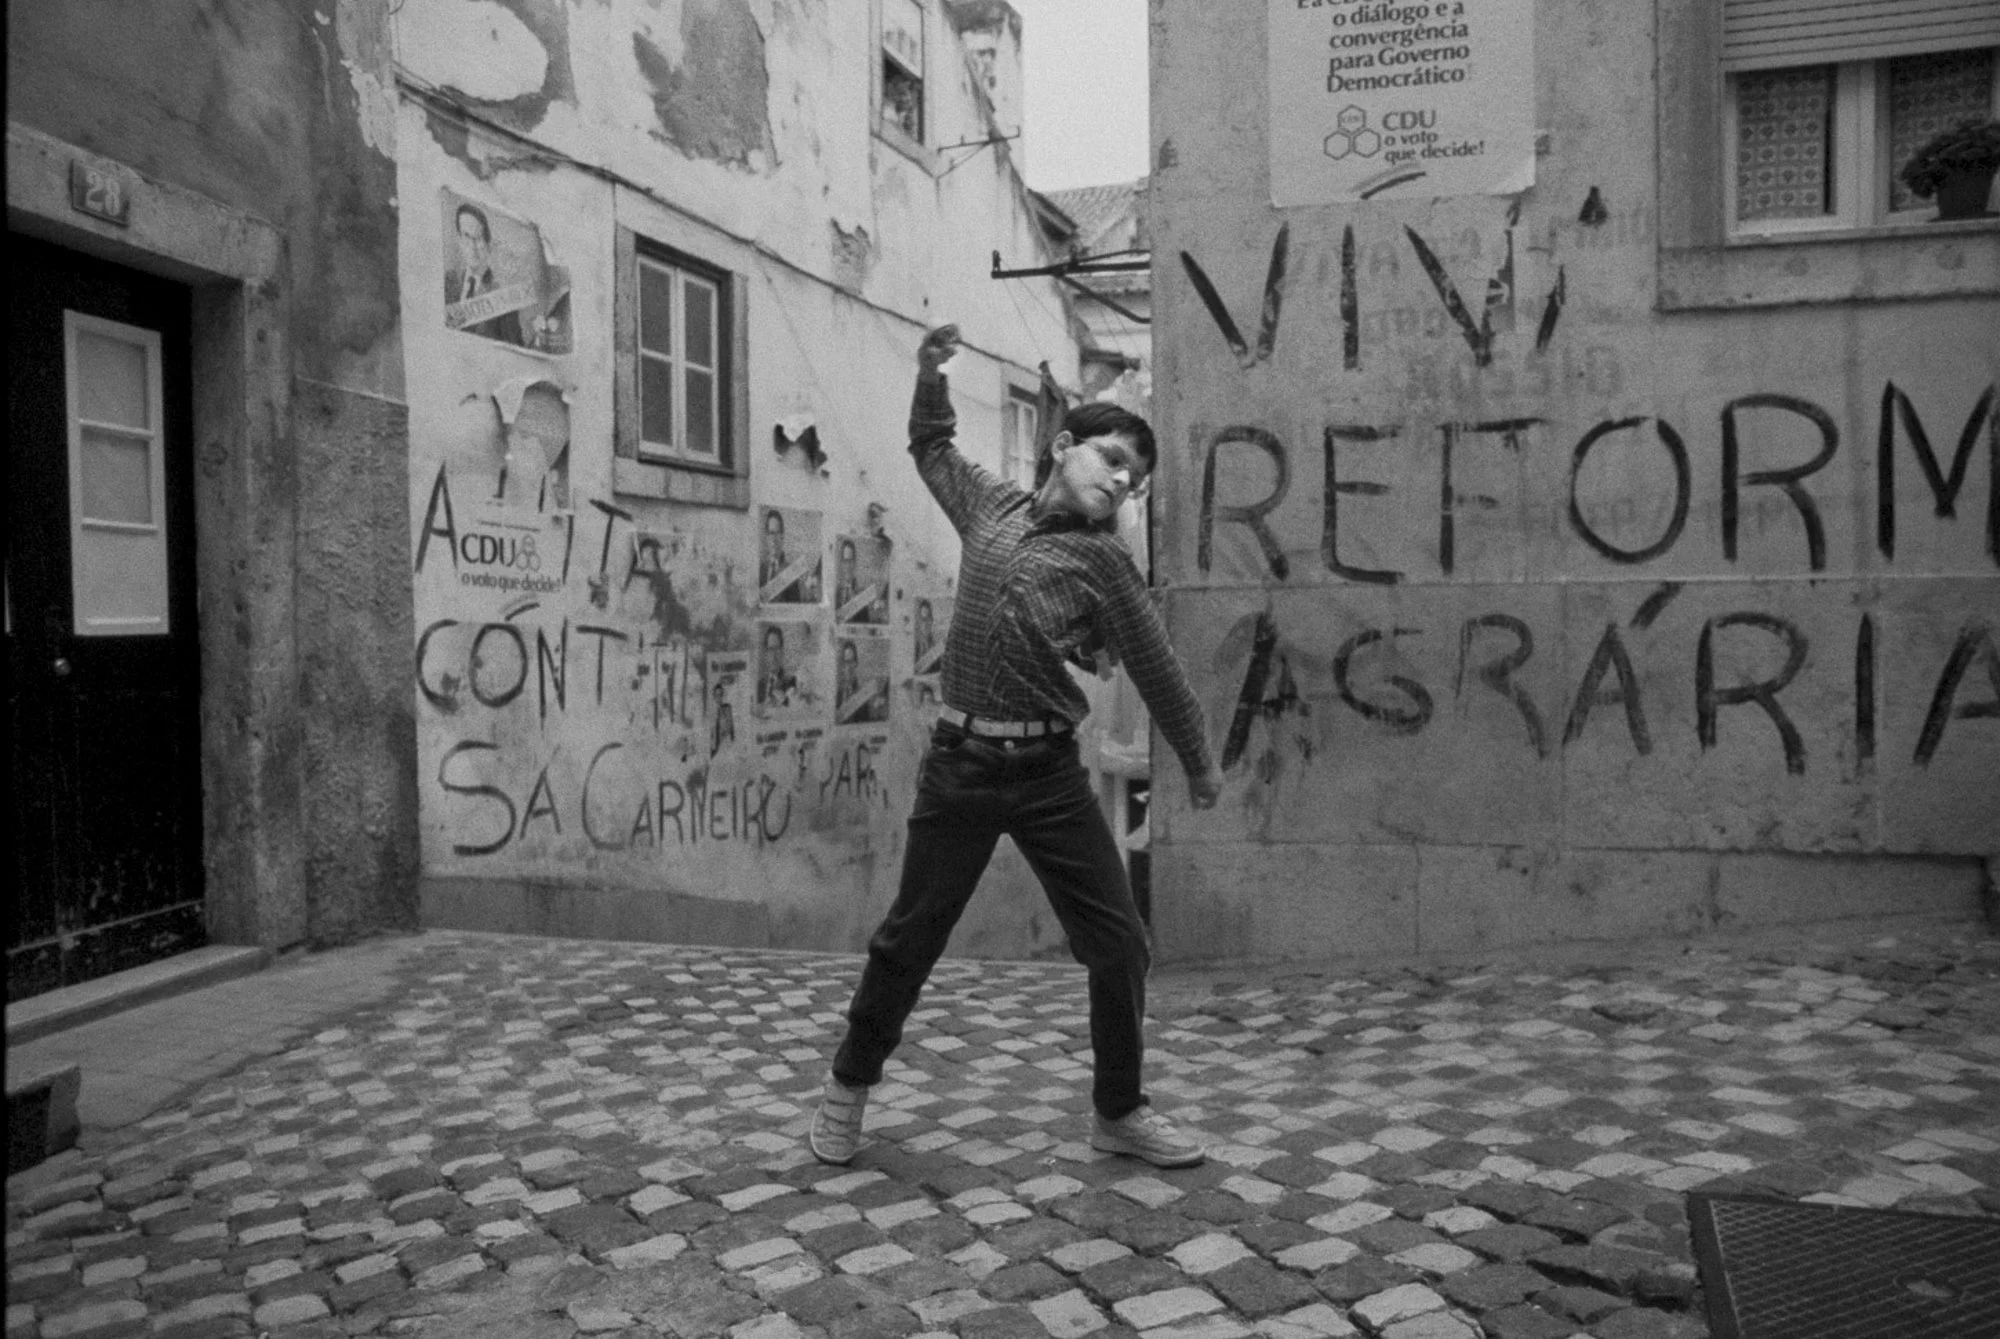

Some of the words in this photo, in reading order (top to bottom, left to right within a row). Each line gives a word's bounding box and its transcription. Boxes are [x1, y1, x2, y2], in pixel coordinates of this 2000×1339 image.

[1333, 13, 1347, 27] o
[1350, 2, 1430, 26] diálogo
[1435, 3, 1449, 17] e
[1452, 1, 1465, 16] a
[1328, 19, 1470, 49] convergência
[1329, 53, 1375, 75] para
[1377, 44, 1470, 67] Governo
[1326, 66, 1466, 93] Democrático
[1382, 110, 1437, 131] CDU
[1384, 136, 1396, 147] o
[1400, 131, 1439, 145] voto
[1384, 149, 1417, 165] que
[1421, 140, 1486, 159] decide!
[460, 533, 516, 568] CDU
